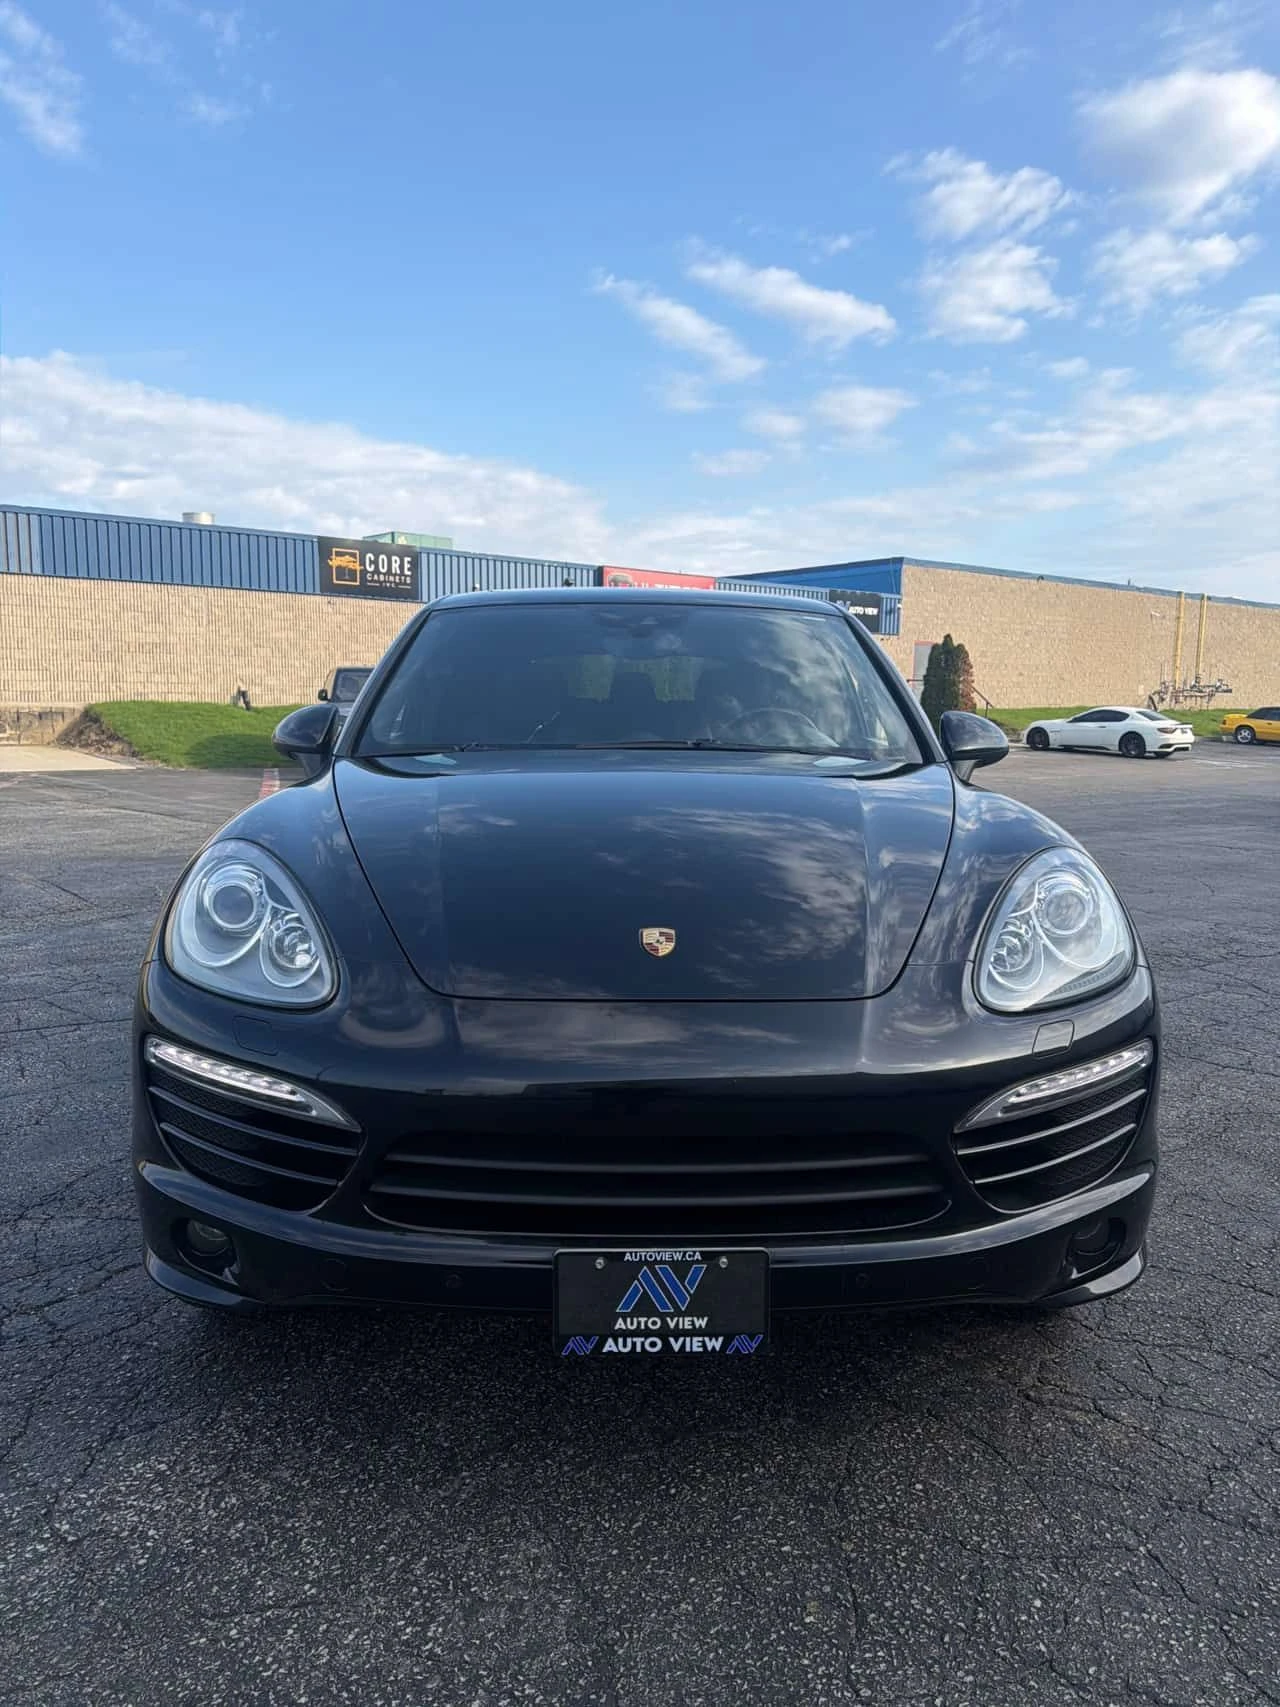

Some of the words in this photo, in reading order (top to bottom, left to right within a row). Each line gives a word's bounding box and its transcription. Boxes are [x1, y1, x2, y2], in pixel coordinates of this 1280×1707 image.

[365, 552, 412, 576] CORE
[366, 573, 411, 584] CABINETS
[848, 606, 864, 615] AUTO
[864, 607, 879, 615] VIEW
[624, 1251, 702, 1261] AUTOVIEW.CA
[614, 1317, 661, 1329] AUTO
[666, 1316, 708, 1329] VIEW
[602, 1337, 662, 1353] AUTO
[669, 1336, 724, 1352] VIEW
